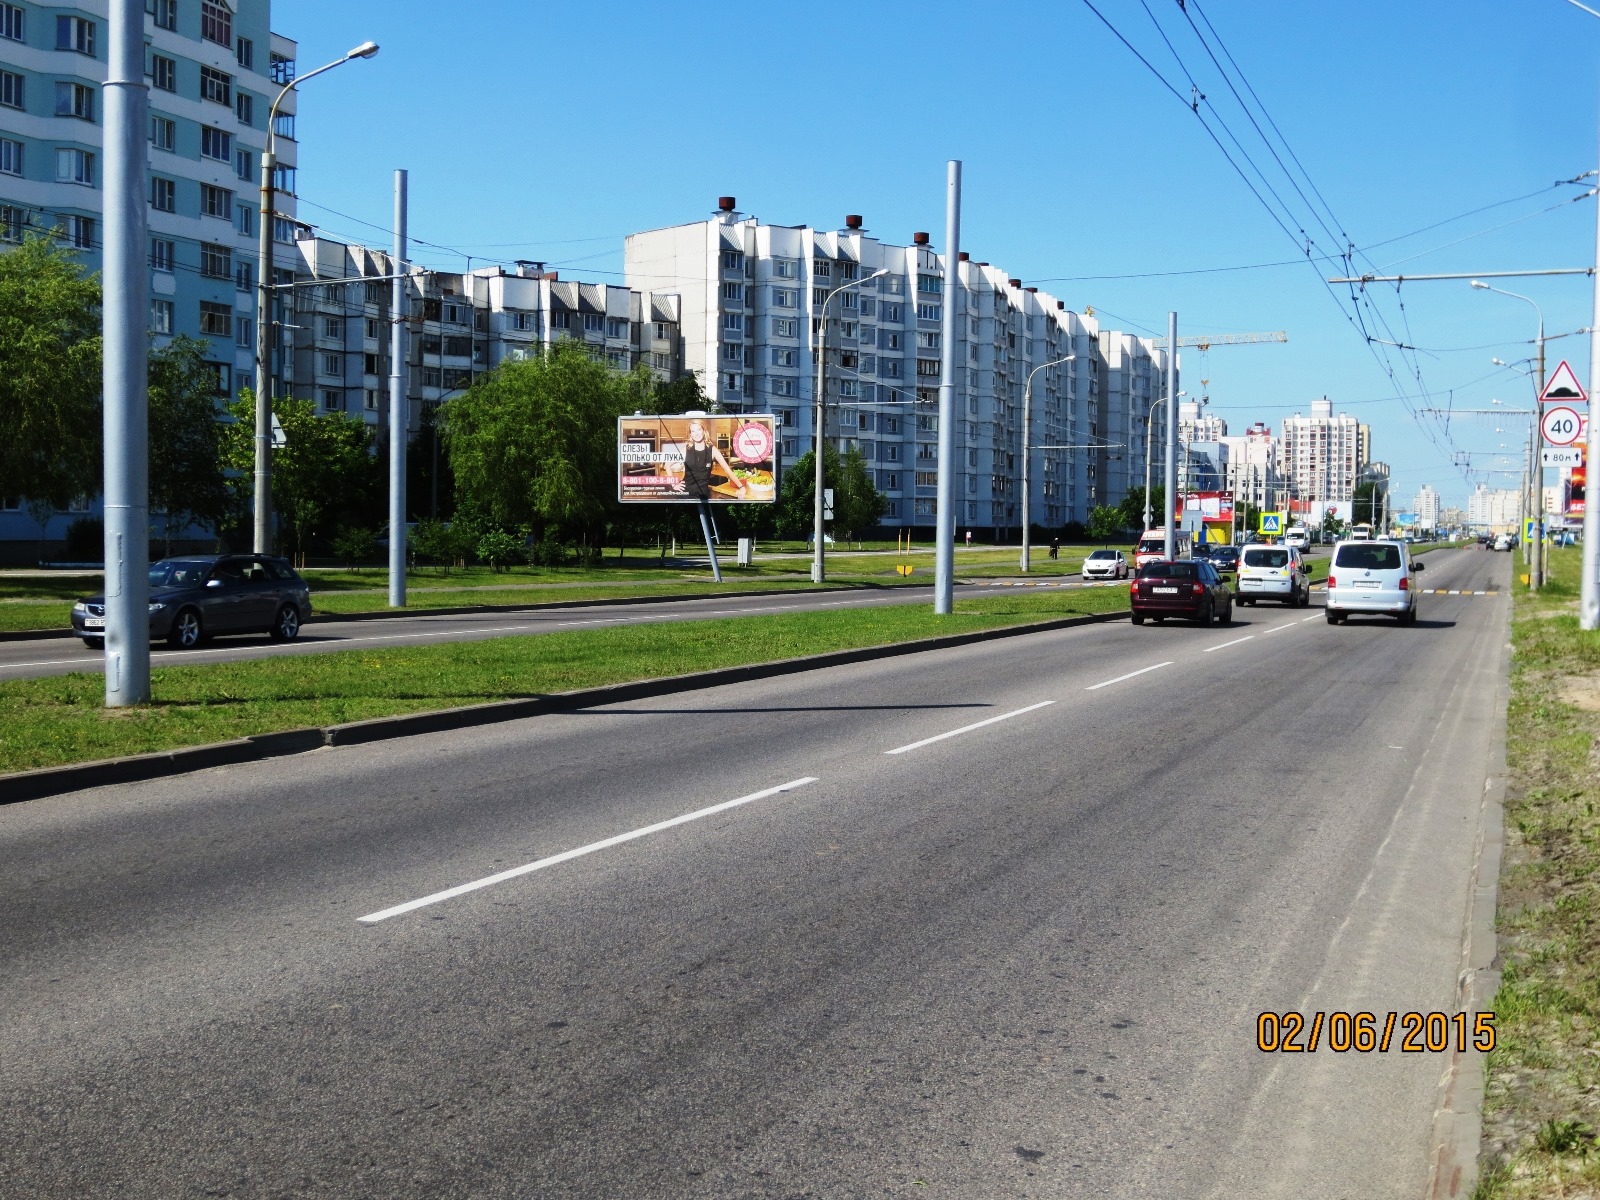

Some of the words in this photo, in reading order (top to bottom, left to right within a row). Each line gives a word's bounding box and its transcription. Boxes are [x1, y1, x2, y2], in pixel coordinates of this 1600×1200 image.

[1551, 419, 1573, 434] 40
[622, 444, 648, 453] СЛЕЗЫ
[622, 453, 651, 462] ТОЛЬКО
[652, 453, 662, 462] ОТ
[663, 453, 684, 462] ЛУКА
